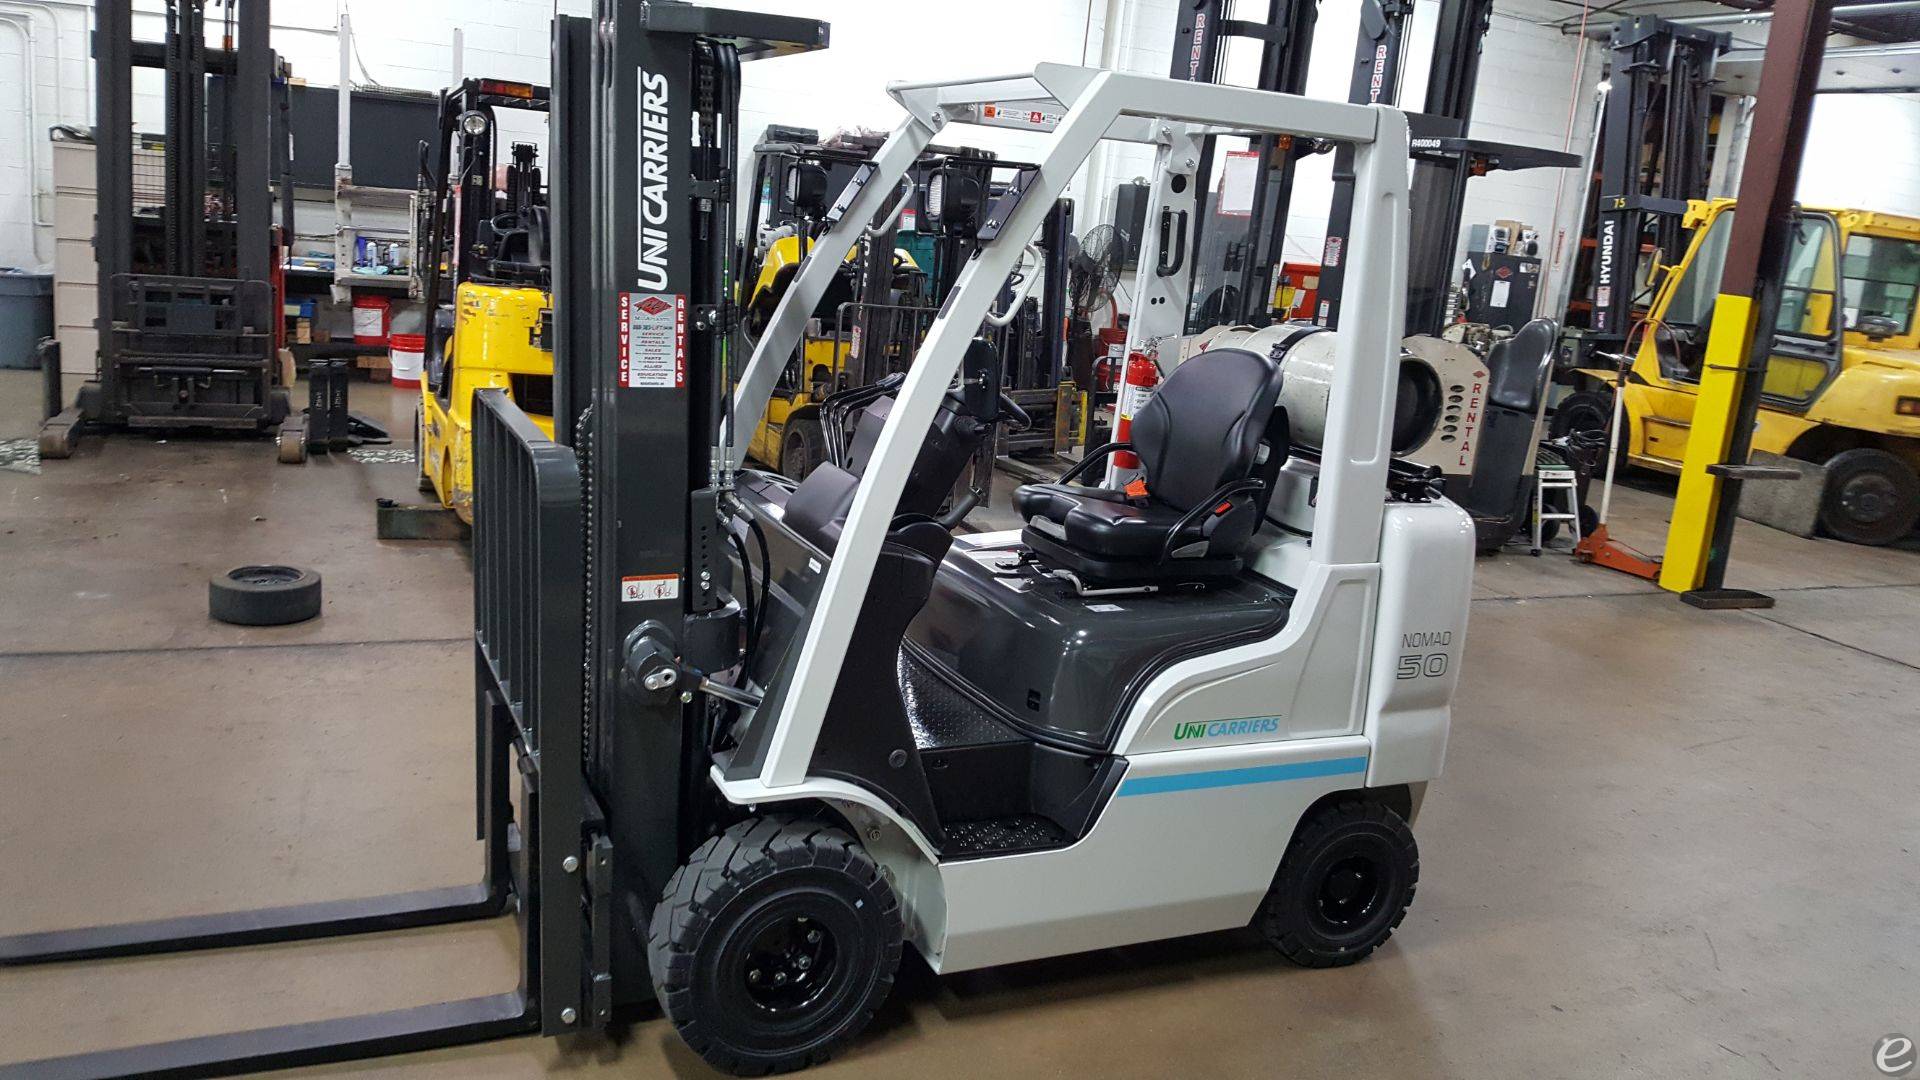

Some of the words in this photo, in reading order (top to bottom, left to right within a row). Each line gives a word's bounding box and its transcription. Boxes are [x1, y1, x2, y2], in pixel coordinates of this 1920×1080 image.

[1600, 220, 1615, 285] HYUNDAI
[621, 296, 629, 382] SERVICE
[677, 298, 685, 382] RENTALS
[1459, 382, 1483, 467] RENTAL
[1397, 653, 1449, 680] 50
[1402, 631, 1452, 648] NOMAD
